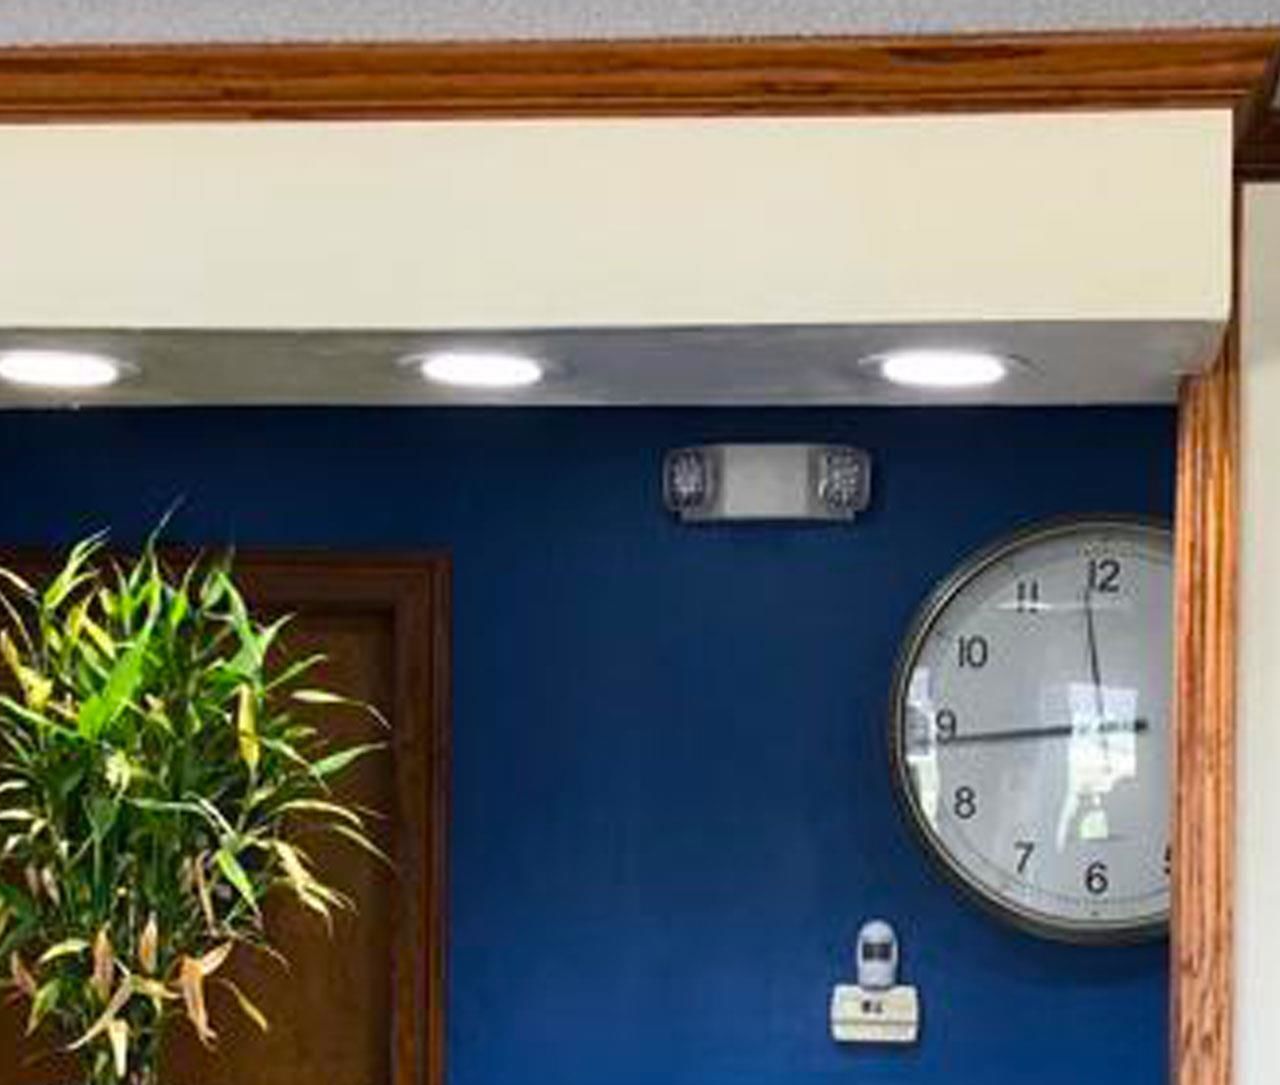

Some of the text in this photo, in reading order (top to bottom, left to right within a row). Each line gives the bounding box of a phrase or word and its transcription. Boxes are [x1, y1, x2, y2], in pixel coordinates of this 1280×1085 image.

[1088, 560, 1120, 593] 12
[1017, 583, 1039, 614] 11
[958, 637, 988, 668] 10
[936, 710, 957, 743] 9
[954, 787, 977, 819] 8
[1016, 842, 1036, 874] 7
[1086, 863, 1109, 894] 6
